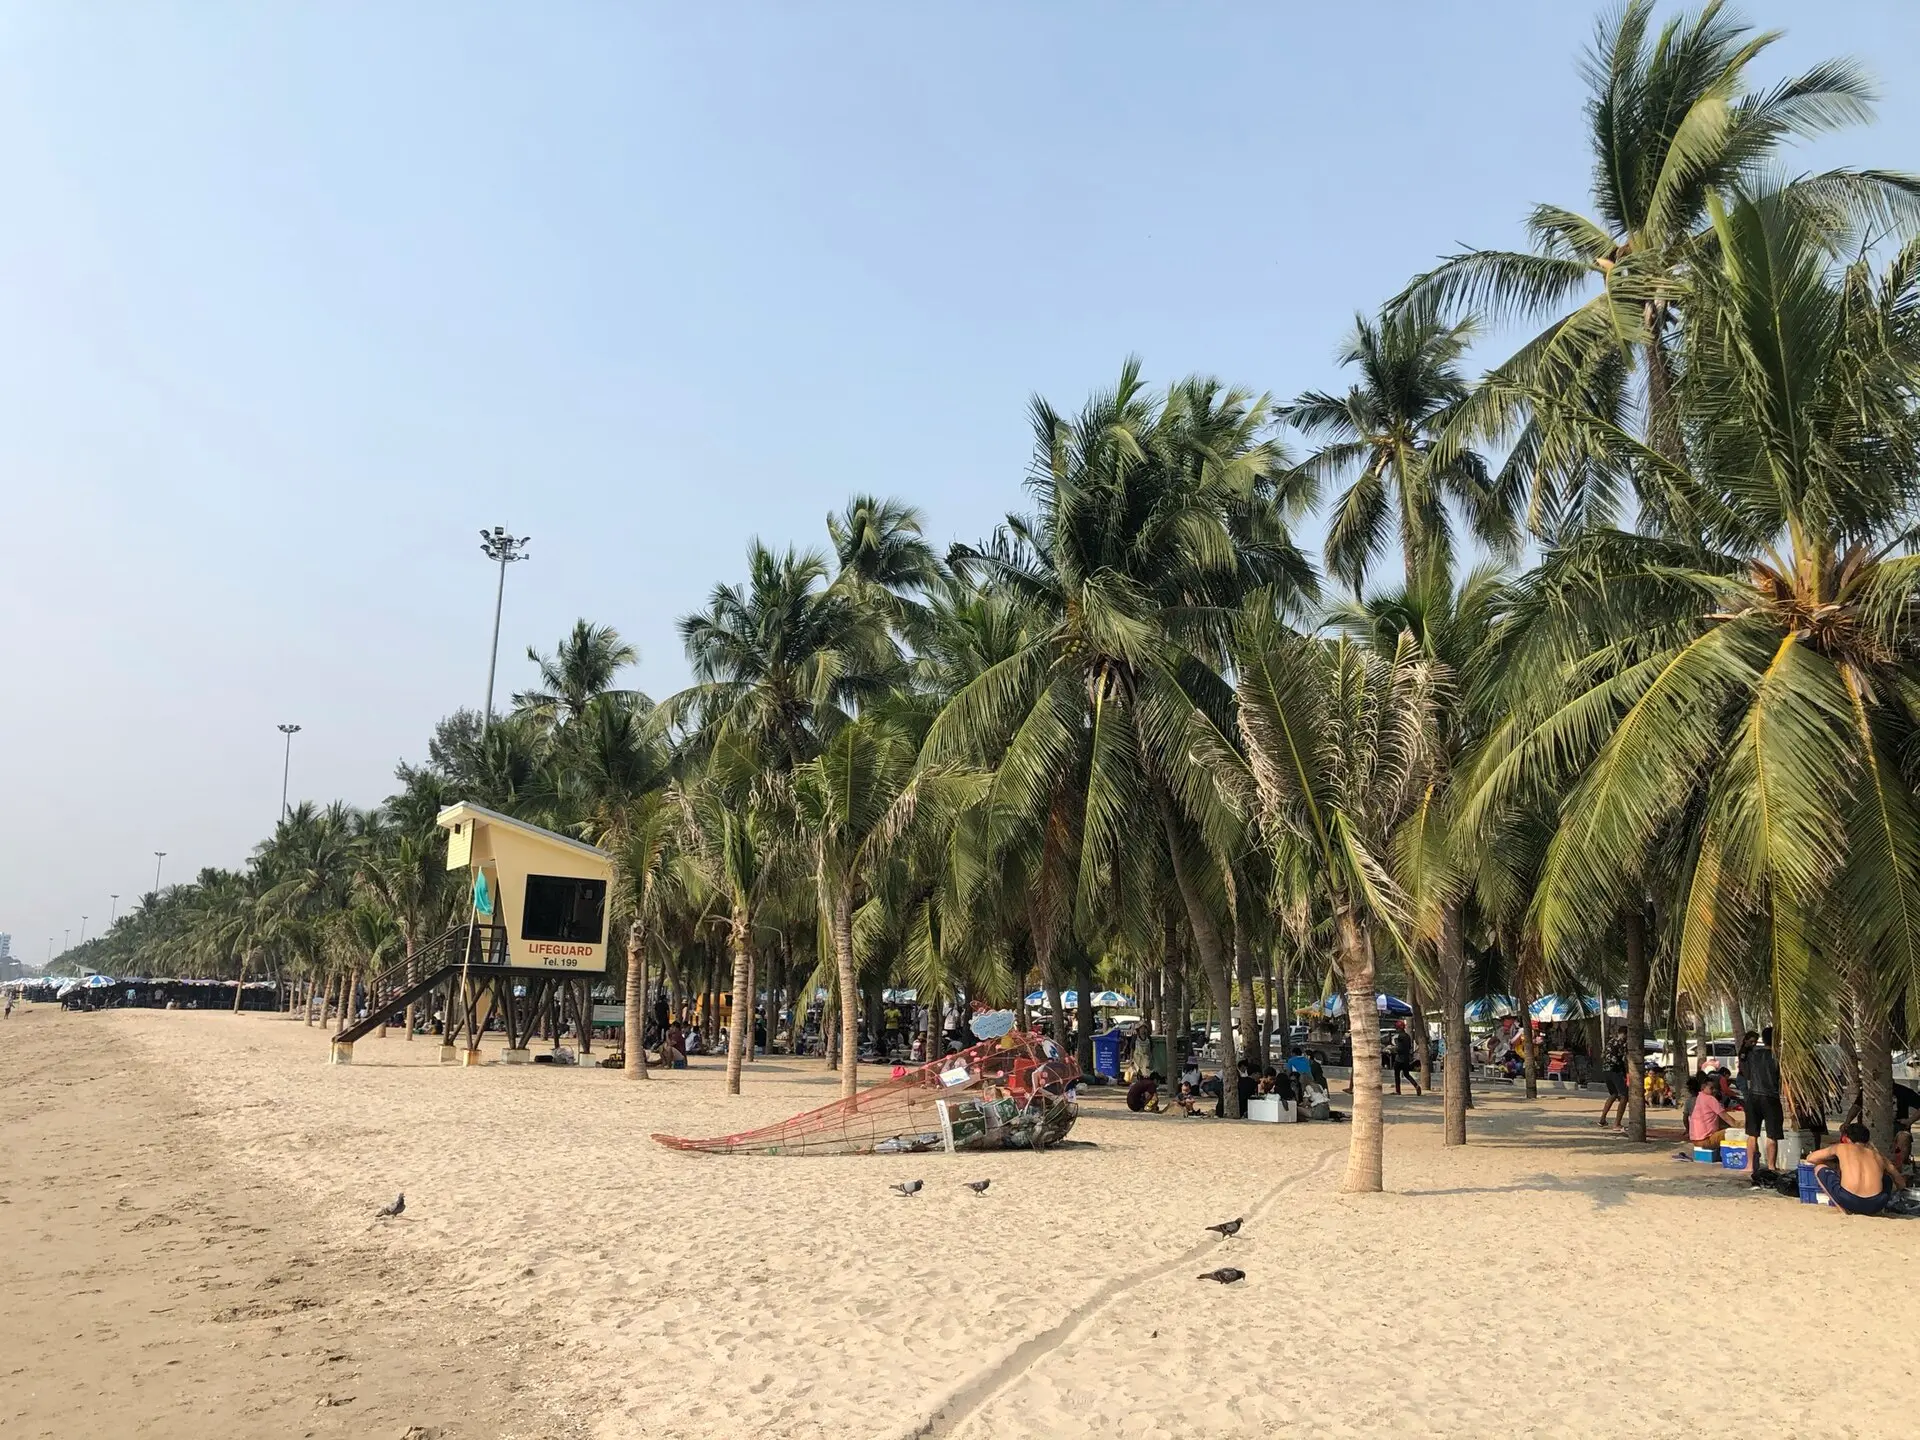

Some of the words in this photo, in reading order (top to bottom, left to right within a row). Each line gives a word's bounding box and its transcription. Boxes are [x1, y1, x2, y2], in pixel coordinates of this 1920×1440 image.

[529, 944, 593, 956] LIFEGUARD
[543, 956, 559, 966] Tel.
[561, 958, 578, 967] 199
